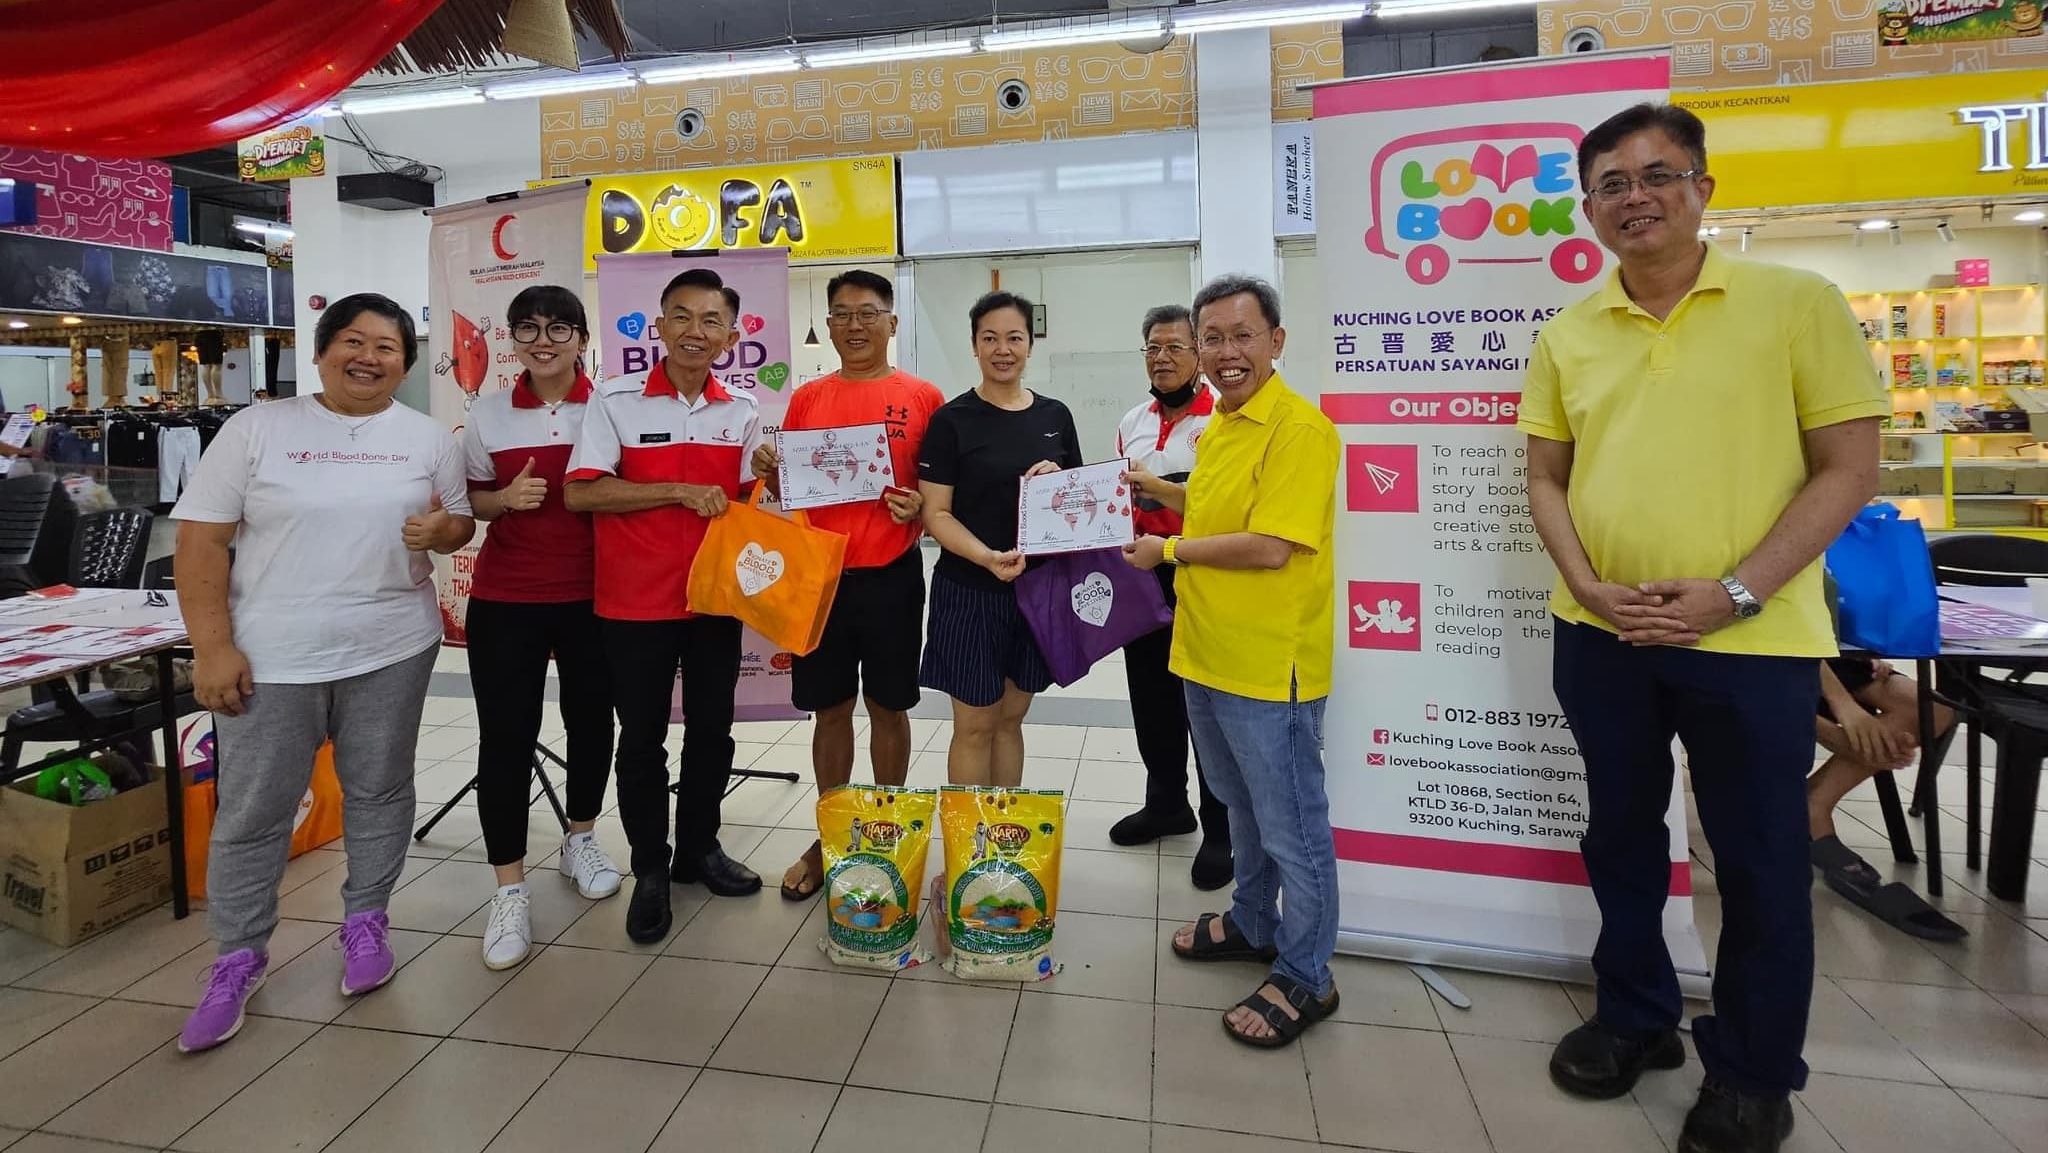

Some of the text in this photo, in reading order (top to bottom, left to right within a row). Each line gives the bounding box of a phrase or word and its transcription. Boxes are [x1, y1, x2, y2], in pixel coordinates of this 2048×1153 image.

[1835, 34, 1872, 46] NEWS
[1677, 43, 1710, 54] NEWS
[1083, 96, 1110, 105] NEWS
[1724, 95, 1790, 107] KECANTIKAN
[843, 114, 869, 125] NEWS
[959, 107, 985, 117] NEWS
[852, 160, 886, 171] SN64A
[1401, 144, 1574, 198] LOVE
[1303, 185, 1312, 221] Hollow
[602, 178, 804, 252] DOFA
[1397, 197, 1576, 241] BOOK
[1334, 312, 1411, 326] KUCHING
[1416, 310, 1465, 324] LOVE
[1471, 309, 1526, 323] BOOK
[1335, 358, 1519, 373] PERSATUAN SAYANGI
[764, 368, 785, 382] AB
[1390, 396, 1521, 421] Our Obje
[332, 451, 360, 460] Blood
[361, 452, 389, 461] Donor
[391, 454, 409, 462] Day
[1432, 444, 1528, 458] To reach o
[1433, 463, 1448, 476] in
[1462, 464, 1500, 477] rural
[1432, 483, 1529, 498] story book
[1433, 501, 1532, 518] and engag
[1433, 520, 1500, 533] creative
[1433, 540, 1467, 551] arts
[1471, 539, 1482, 552] &
[1486, 540, 1533, 553] crafts
[1434, 584, 1552, 600] To motivat
[1434, 603, 1546, 619] children and
[1435, 621, 1551, 640] develop the
[1436, 642, 1501, 659] reading
[1445, 707, 1570, 729] 012-883 1972
[1393, 731, 1454, 749] Kuching
[1459, 737, 1493, 751] Love
[1497, 740, 1537, 753] Book
[1417, 780, 1581, 807] Lot 10868, Section 64,
[1408, 796, 1446, 810] KTLD
[1450, 800, 1489, 815] 36-D,
[1492, 804, 1533, 818] Jalan
[864, 822, 901, 839] HAPPY
[1409, 813, 1454, 827] 93200
[1458, 817, 1525, 836] Kuching,
[988, 826, 1026, 841] HAPPY
